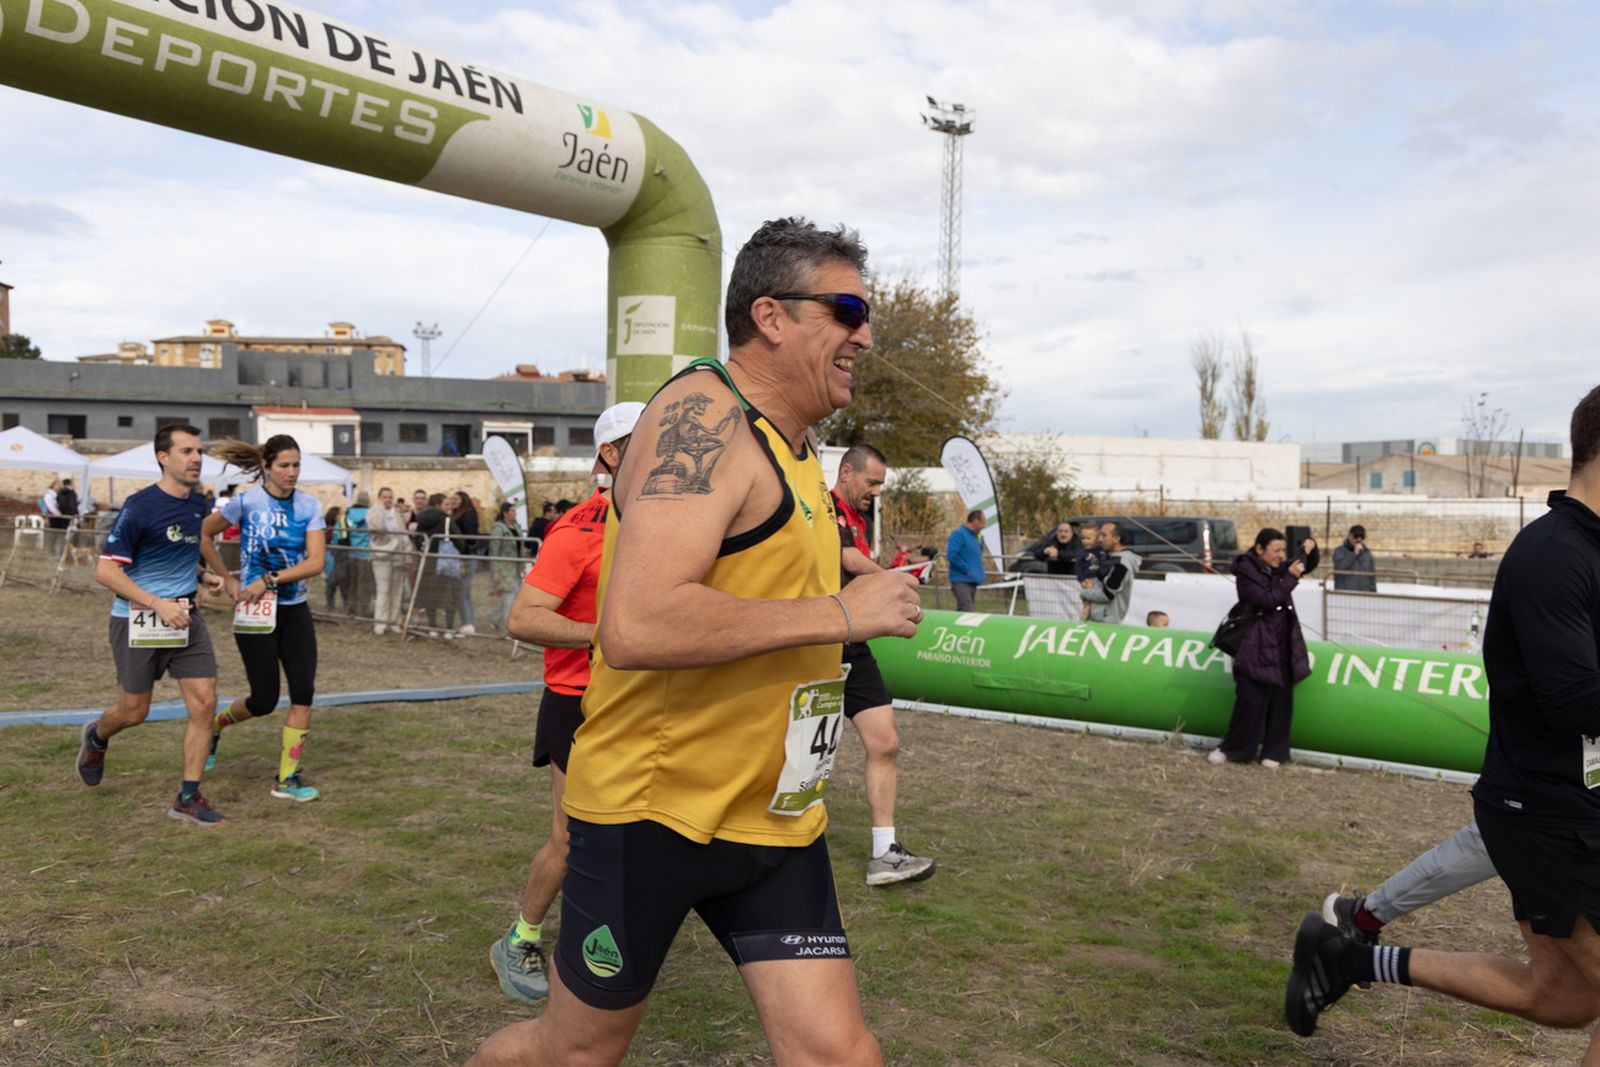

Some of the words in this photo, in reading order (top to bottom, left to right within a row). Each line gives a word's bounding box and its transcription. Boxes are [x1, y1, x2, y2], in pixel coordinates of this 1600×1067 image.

[24, 0, 439, 145] DEPORTES
[322, 22, 395, 76] DE
[408, 50, 524, 115] JAÉN
[558, 131, 629, 184] Jaén
[929, 626, 986, 656] Jaén
[951, 655, 992, 668] INTERIOR
[1014, 624, 1117, 660] JAÉN
[1327, 653, 1489, 700] INTER
